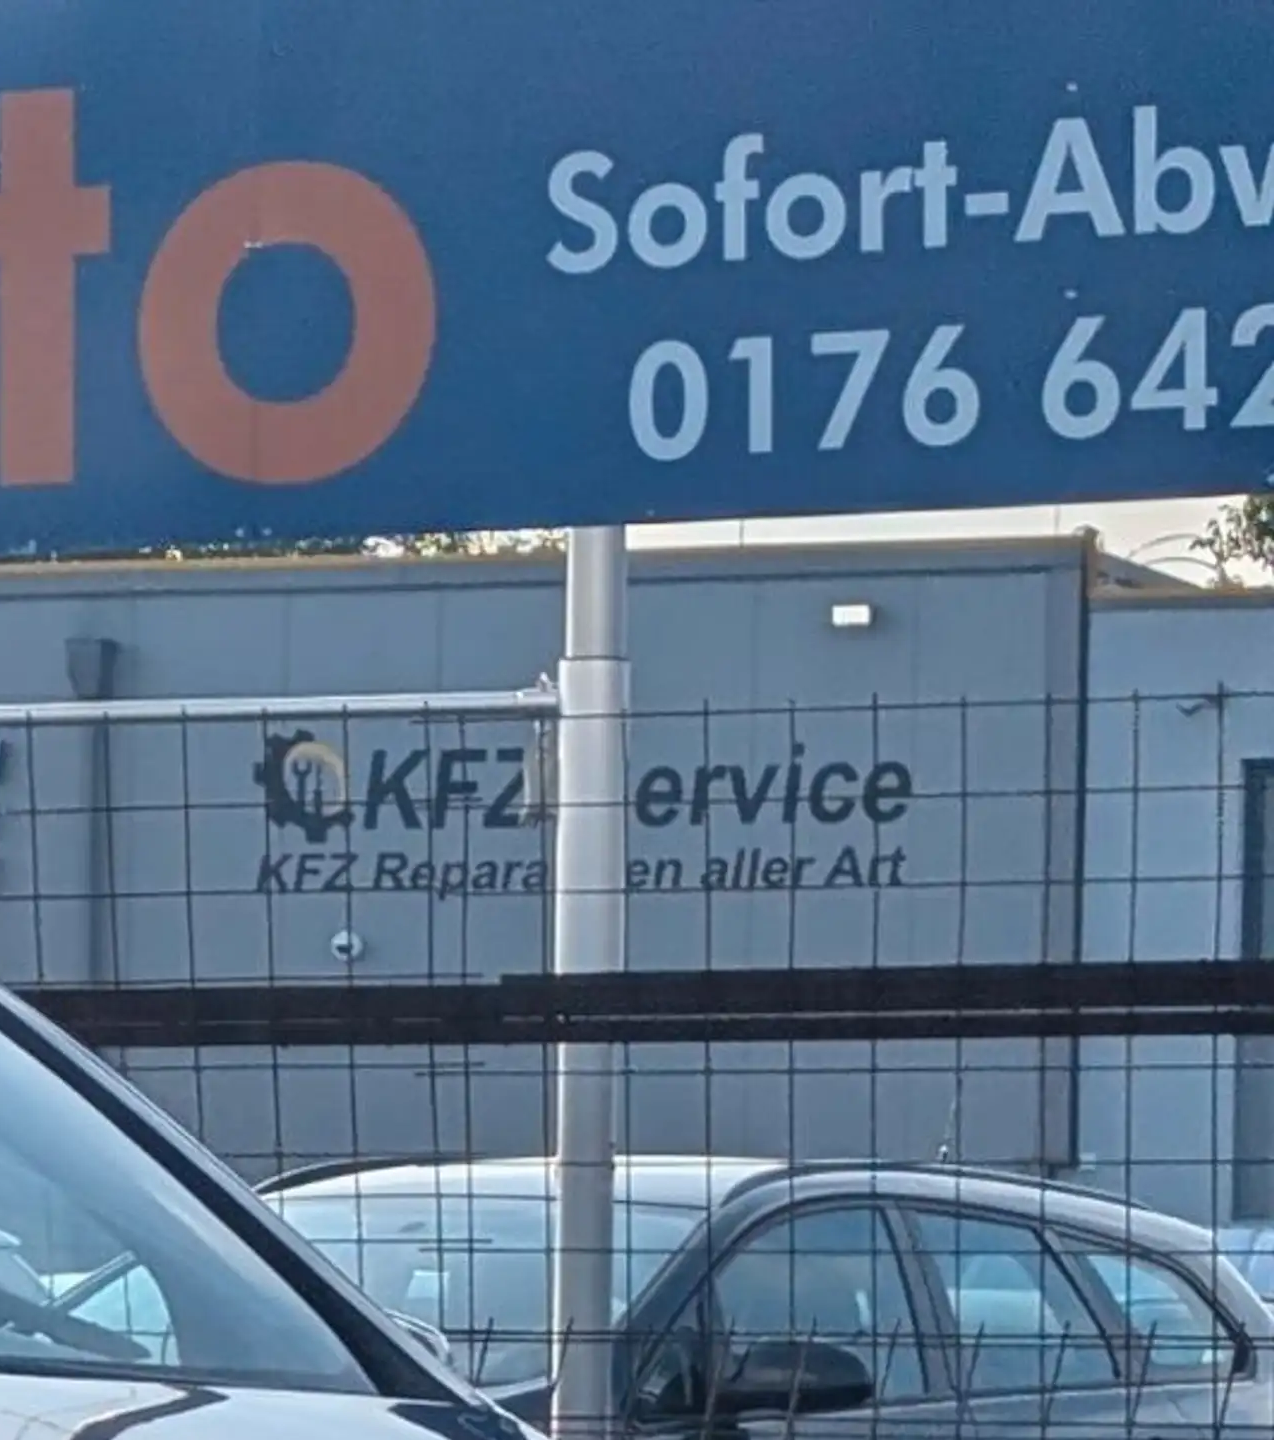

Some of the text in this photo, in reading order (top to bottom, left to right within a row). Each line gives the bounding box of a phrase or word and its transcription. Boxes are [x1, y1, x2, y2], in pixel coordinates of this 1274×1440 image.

[629, 324, 981, 462] 0176
[363, 742, 912, 829] KFZ ervice
[255, 853, 359, 892] KFZ
[700, 848, 816, 888] aller
[823, 846, 906, 887] Art
